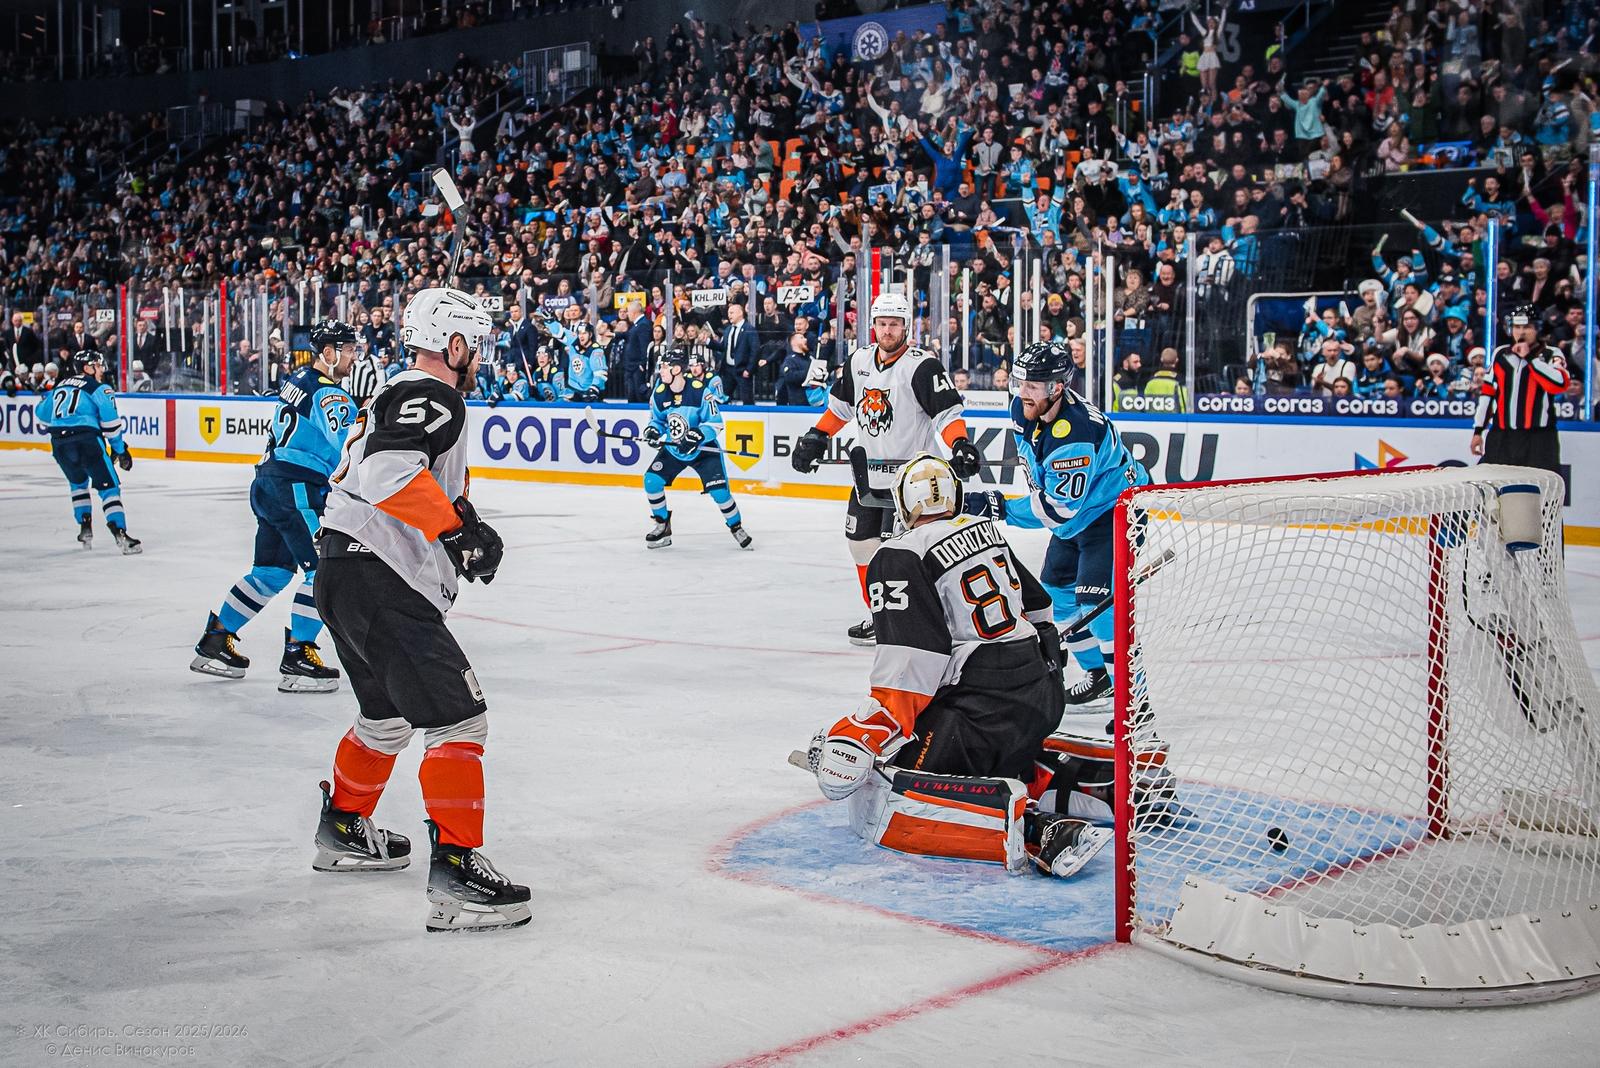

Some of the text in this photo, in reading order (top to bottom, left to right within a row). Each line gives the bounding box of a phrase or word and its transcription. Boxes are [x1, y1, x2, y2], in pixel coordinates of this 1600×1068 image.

[694, 292, 724, 302] KHL.RU
[53, 388, 82, 419] 21
[1121, 396, 1175, 411] согаз
[1197, 397, 1255, 412] согаз
[1264, 398, 1324, 413] согаз
[1335, 398, 1399, 415] согаз
[1410, 399, 1476, 415] согаз
[325, 404, 351, 433] 52
[395, 397, 453, 434] 57
[226, 418, 273, 436] БАНК
[482, 414, 640, 467] согаз
[1053, 459, 1084, 470] WINLINE
[1054, 471, 1088, 500] 20
[867, 580, 909, 614] 83
[465, 880, 497, 897] BAUER
